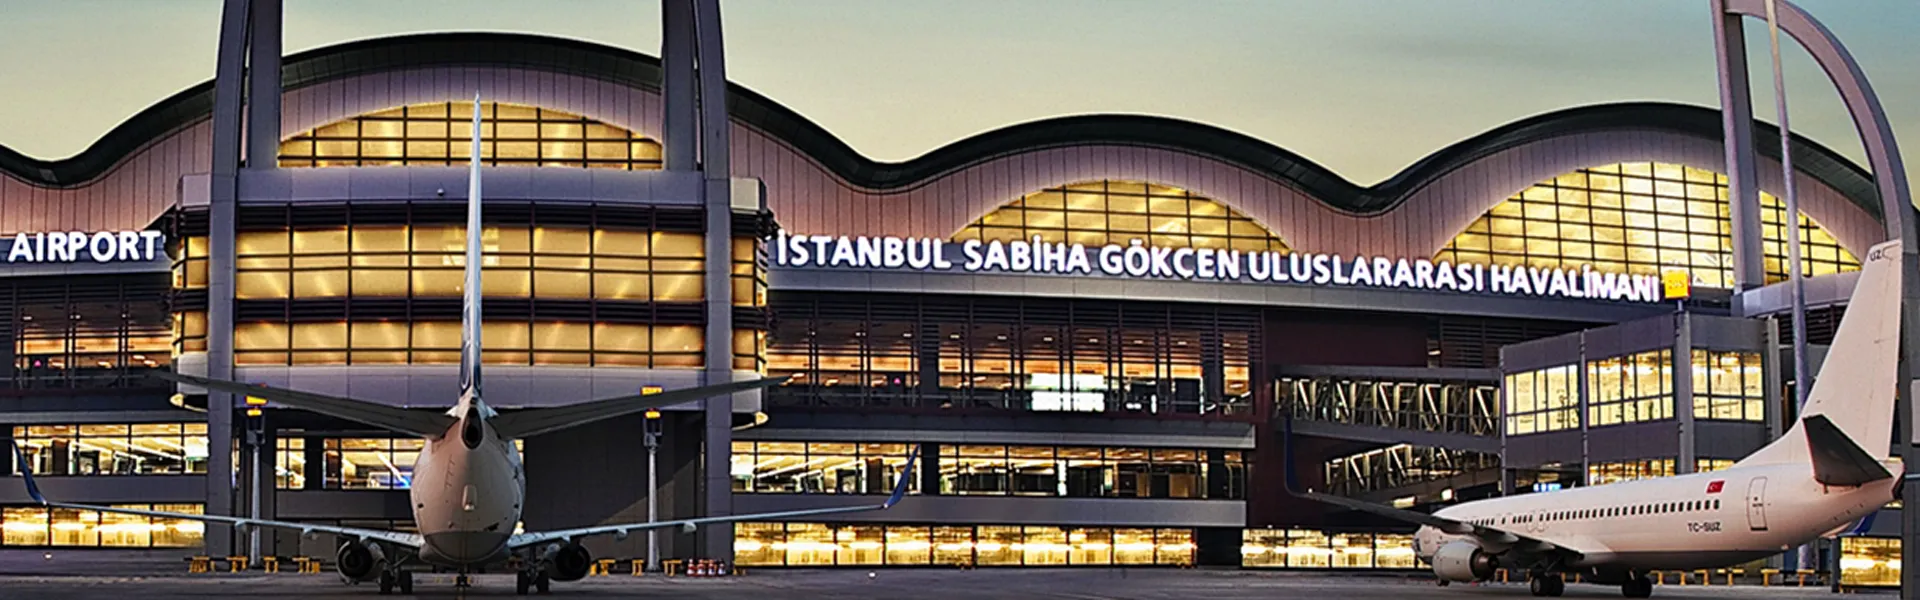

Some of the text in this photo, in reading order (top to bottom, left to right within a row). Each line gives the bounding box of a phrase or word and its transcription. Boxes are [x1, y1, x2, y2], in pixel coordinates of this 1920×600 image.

[8, 230, 162, 262] AIRPORT
[777, 229, 1660, 302] İSTANBUL SABİHA GÖKÇEN ULUSLARARASI HAVALİMANI
